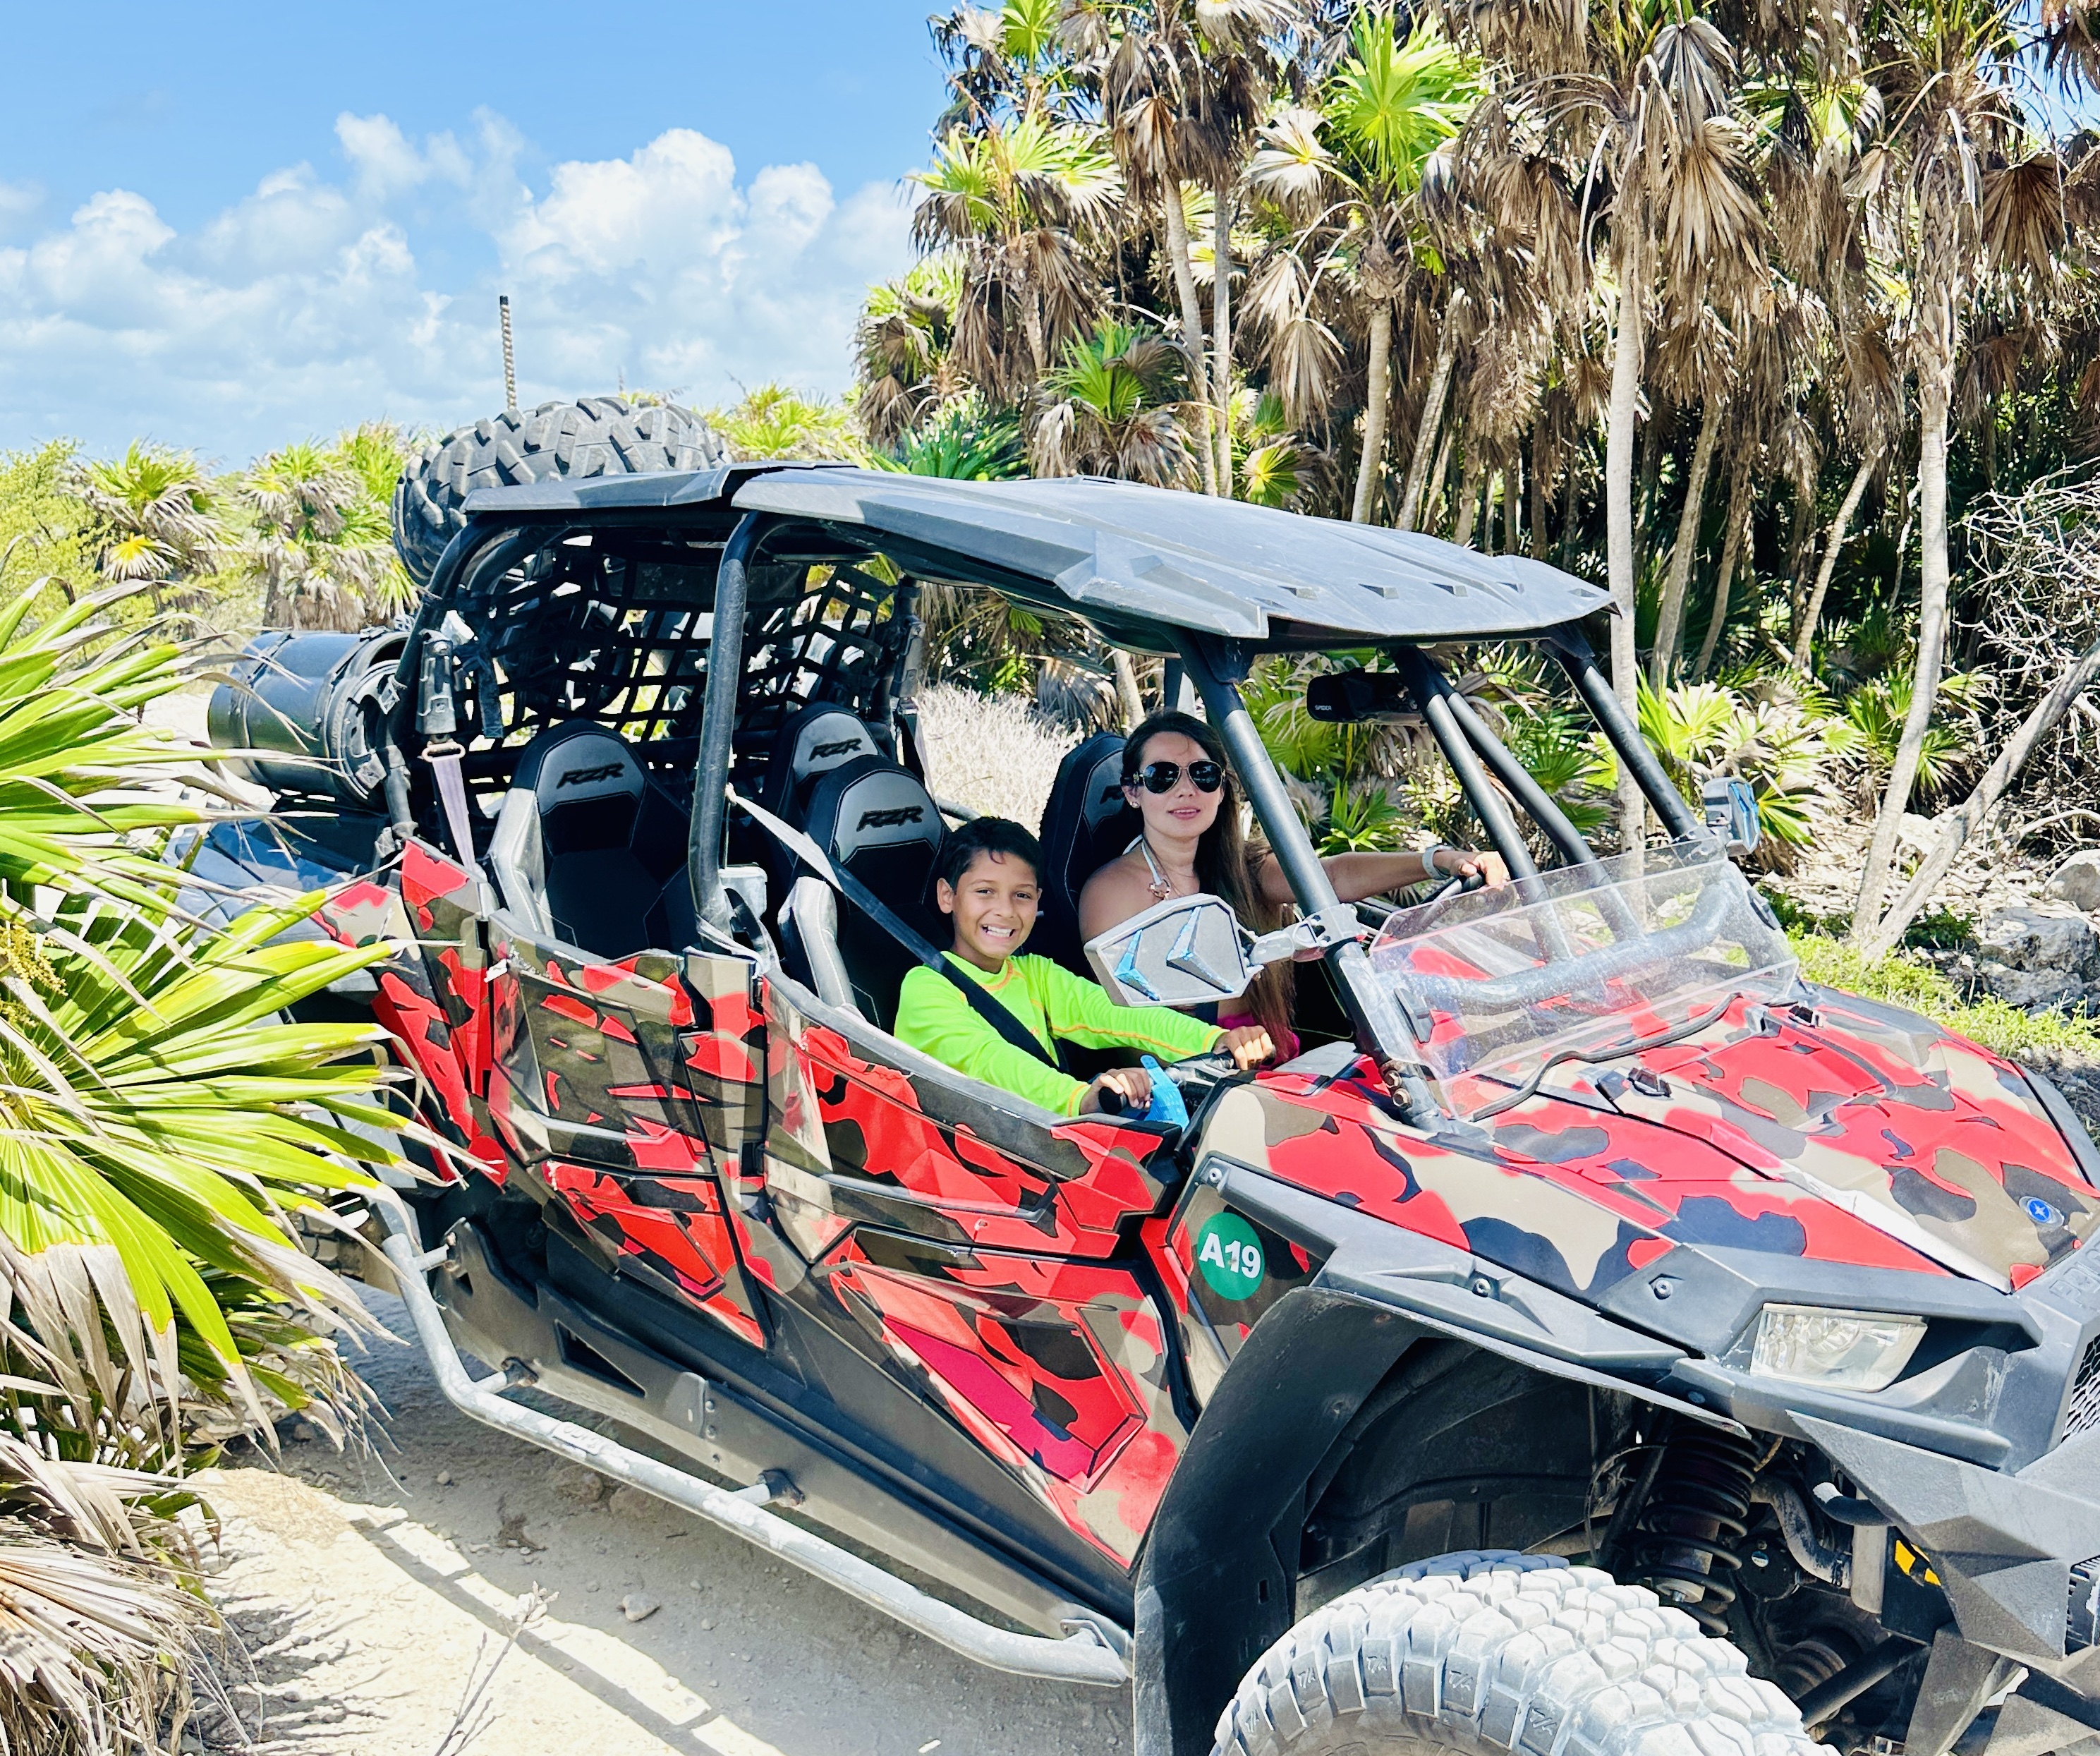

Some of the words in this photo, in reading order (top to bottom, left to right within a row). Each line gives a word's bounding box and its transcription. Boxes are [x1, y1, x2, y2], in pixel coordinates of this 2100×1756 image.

[809, 738, 862, 761] RZR
[557, 762, 625, 789] RZR
[856, 806, 924, 832] RZR
[1199, 1232, 1261, 1278] A19
